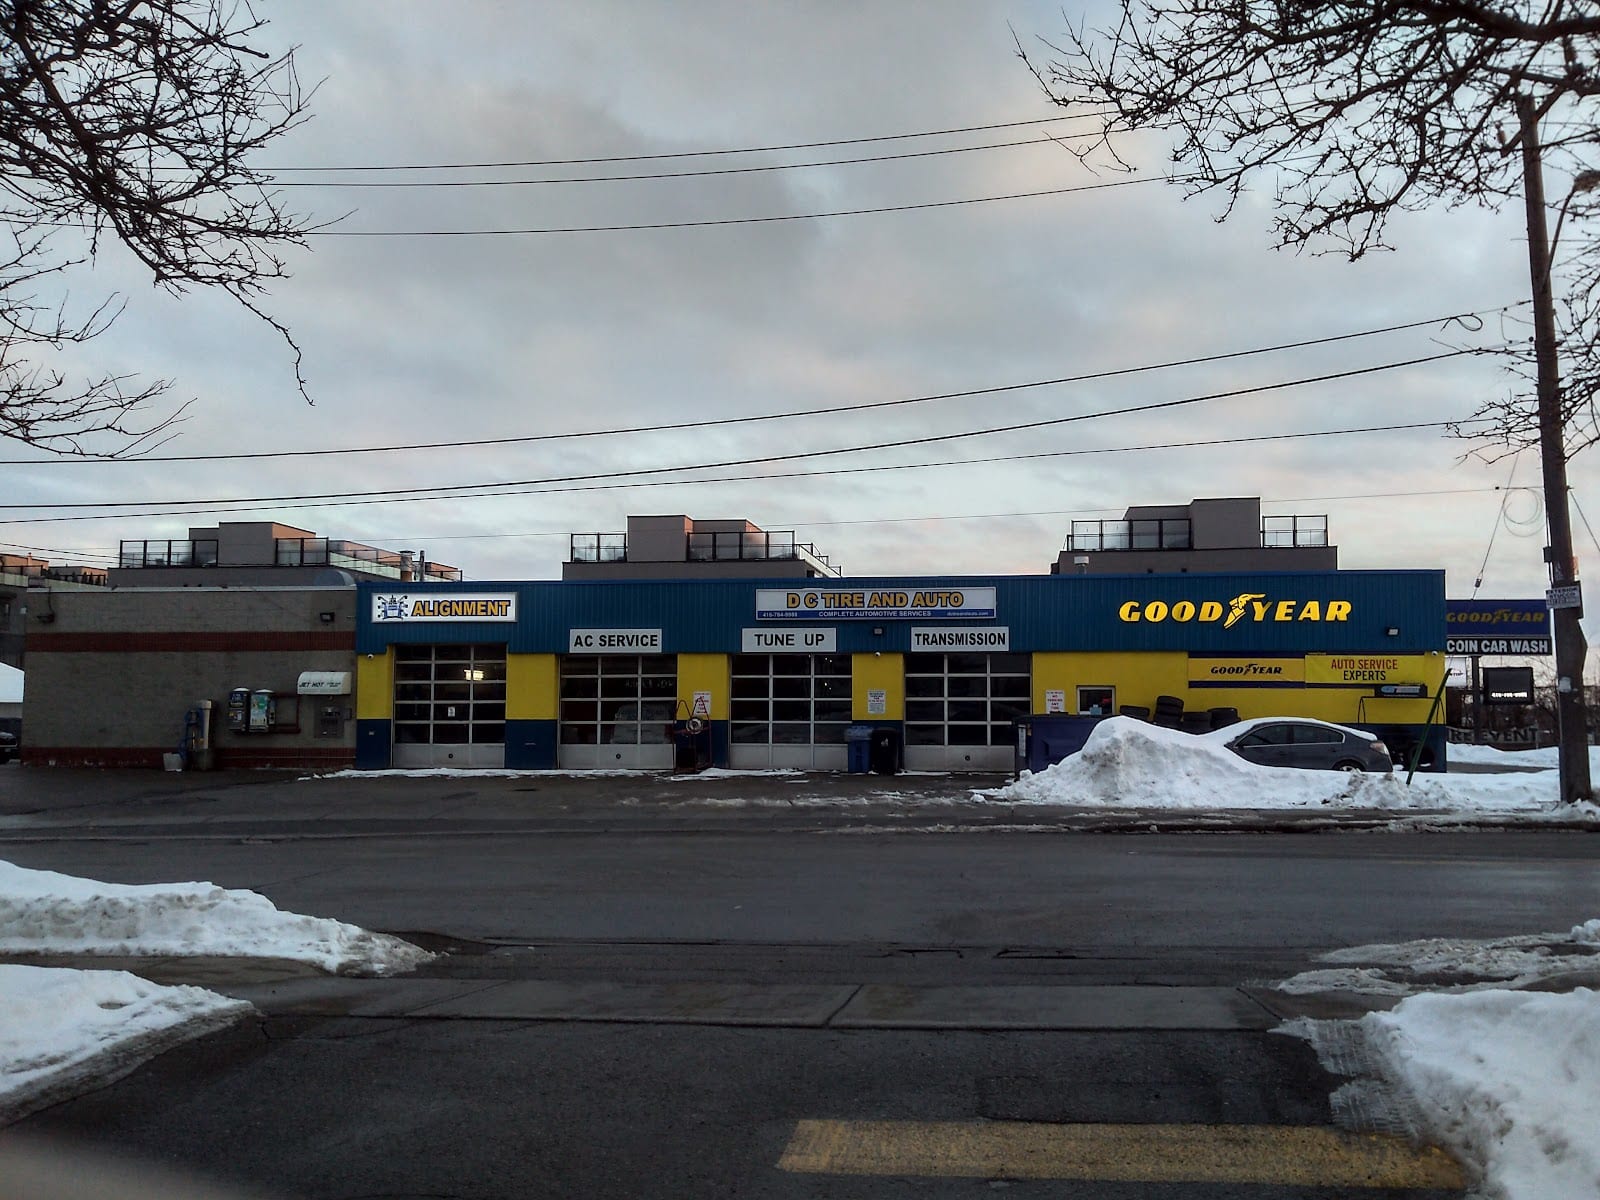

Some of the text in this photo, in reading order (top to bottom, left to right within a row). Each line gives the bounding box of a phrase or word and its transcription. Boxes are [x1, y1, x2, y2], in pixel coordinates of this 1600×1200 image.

[786, 592, 964, 608] D C TIRE AND AUTO
[411, 600, 510, 617] ALIGNMENT
[573, 634, 658, 647] AC SERVICE
[754, 633, 825, 646] TUNE UP
[914, 632, 1006, 646] TRANSMISSION
[1447, 640, 1548, 653] COIN CAR WASH
[1331, 659, 1398, 670] AUTO SERVICE
[1343, 670, 1386, 681] EXPERTS
[1480, 728, 1538, 742] EVENT
